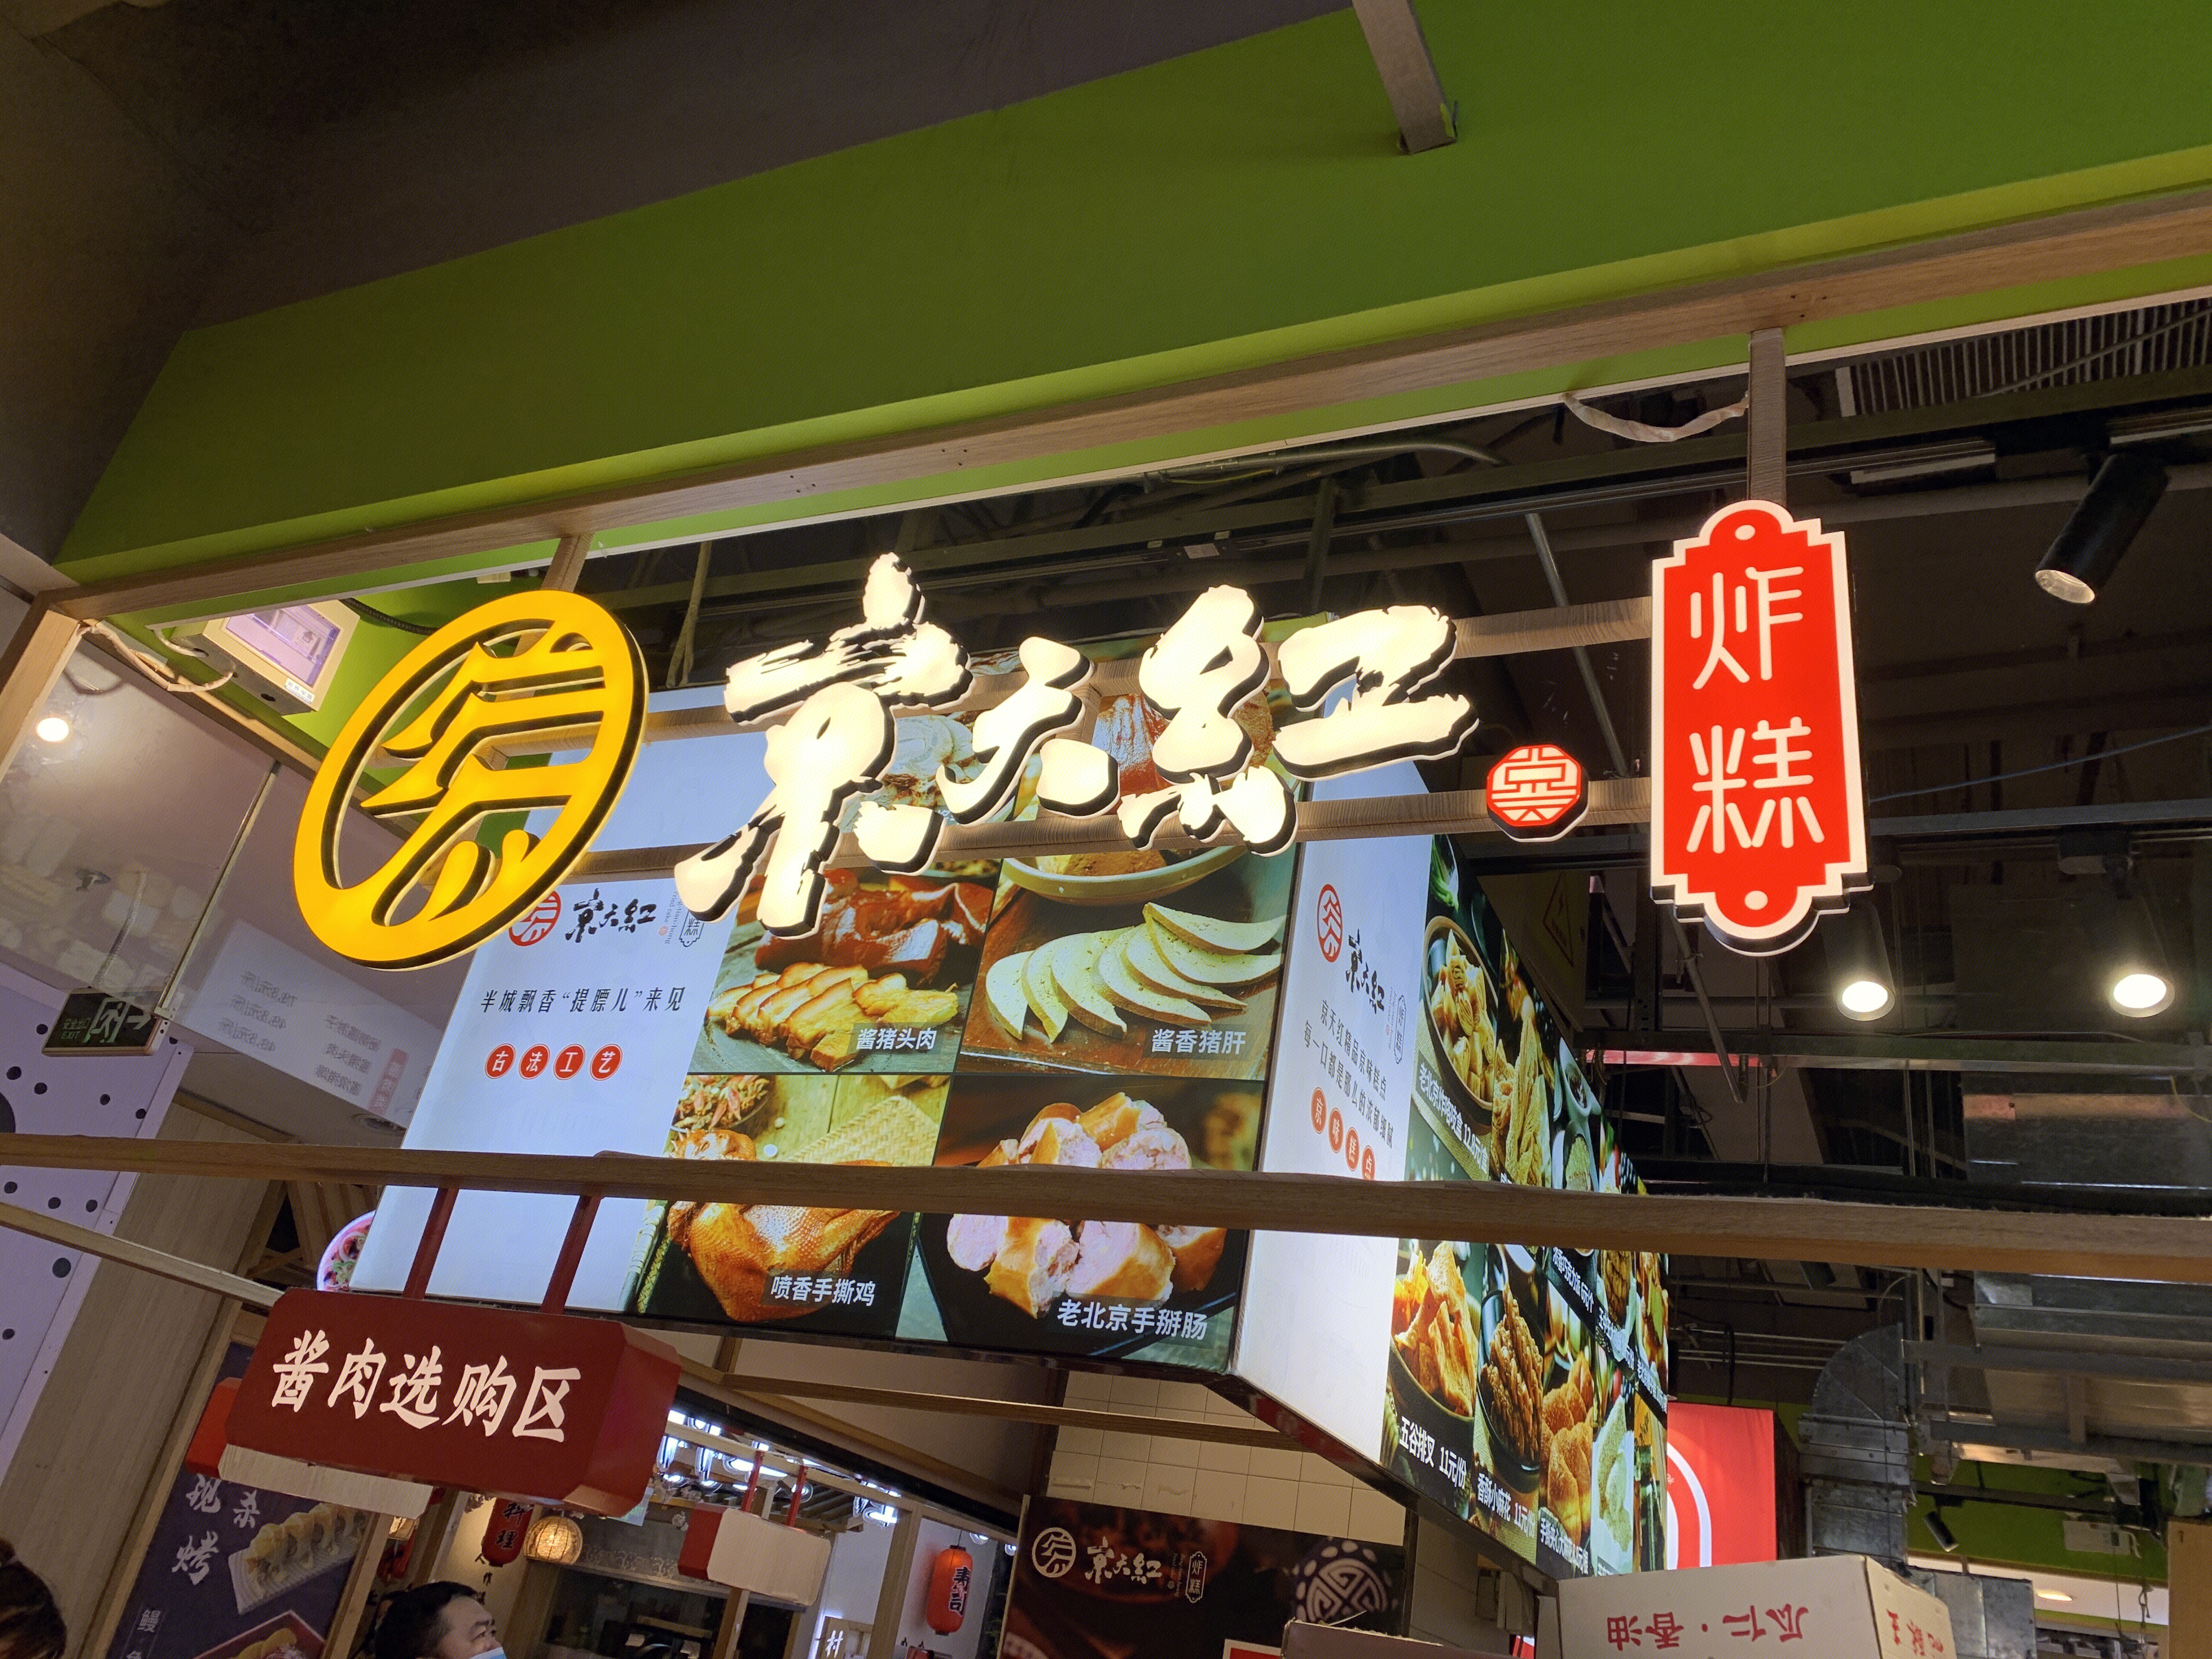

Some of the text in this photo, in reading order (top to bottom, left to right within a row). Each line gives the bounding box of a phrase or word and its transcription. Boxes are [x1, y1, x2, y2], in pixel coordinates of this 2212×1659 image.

[1686, 566, 1825, 854] 炸糕
[480, 986, 685, 1014] 半城飘香“提膘儿”来见
[60, 1031, 81, 1040] EXIT
[61, 1017, 91, 1029] 安全出口
[857, 1028, 937, 1052] 酱猪头肉
[1150, 1029, 1246, 1055] 酱香猪肝
[489, 1049, 616, 1073] 古法工艺
[1321, 998, 1387, 1102] 京天红精品京味糕点
[1304, 1019, 1393, 1149] 每一口都是那么的浓郁细腻
[1314, 1096, 1373, 1181] 京味糕点
[770, 1275, 876, 1307] 喷香手撕鸡
[1057, 1298, 1208, 1340] 老北京手掰肠
[272, 1329, 581, 1443] 酱肉选购区
[1399, 1415, 1468, 1489] 五谷排叉 11元/份
[1477, 1472, 1511, 1522] 香酥小麻花
[1188, 1560, 1203, 1594] 炸糕
